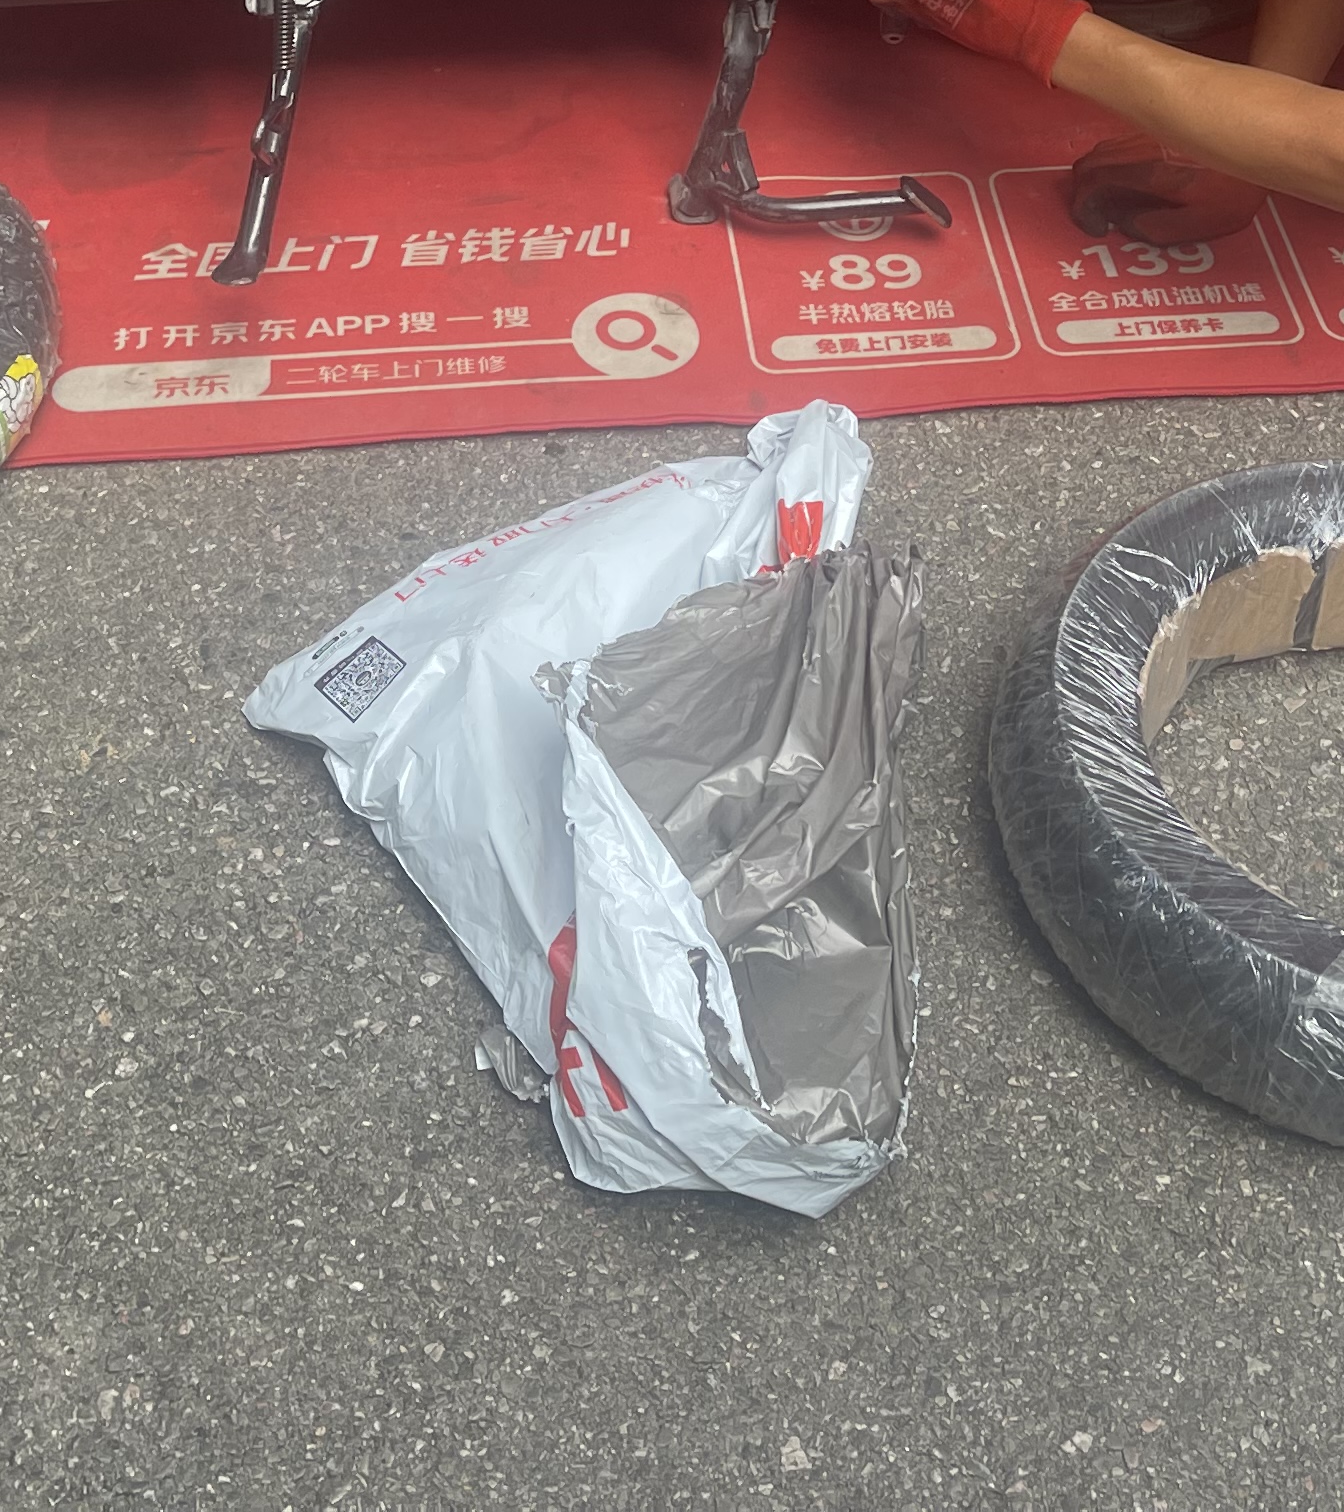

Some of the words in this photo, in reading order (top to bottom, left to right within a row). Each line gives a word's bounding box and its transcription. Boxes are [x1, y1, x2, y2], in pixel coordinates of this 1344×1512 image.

[399, 220, 633, 269] 省钱省心
[799, 253, 923, 292] ¥89
[1057, 241, 1217, 281] ¥139
[798, 299, 955, 324] 半热熔轮胎
[1048, 282, 1267, 313] 全合成机油机滤
[1113, 317, 1225, 338] 上门保养卡
[814, 331, 954, 356] 免费上门安装
[286, 354, 508, 385] 二轮车上门维修
[153, 373, 232, 399] 京东
